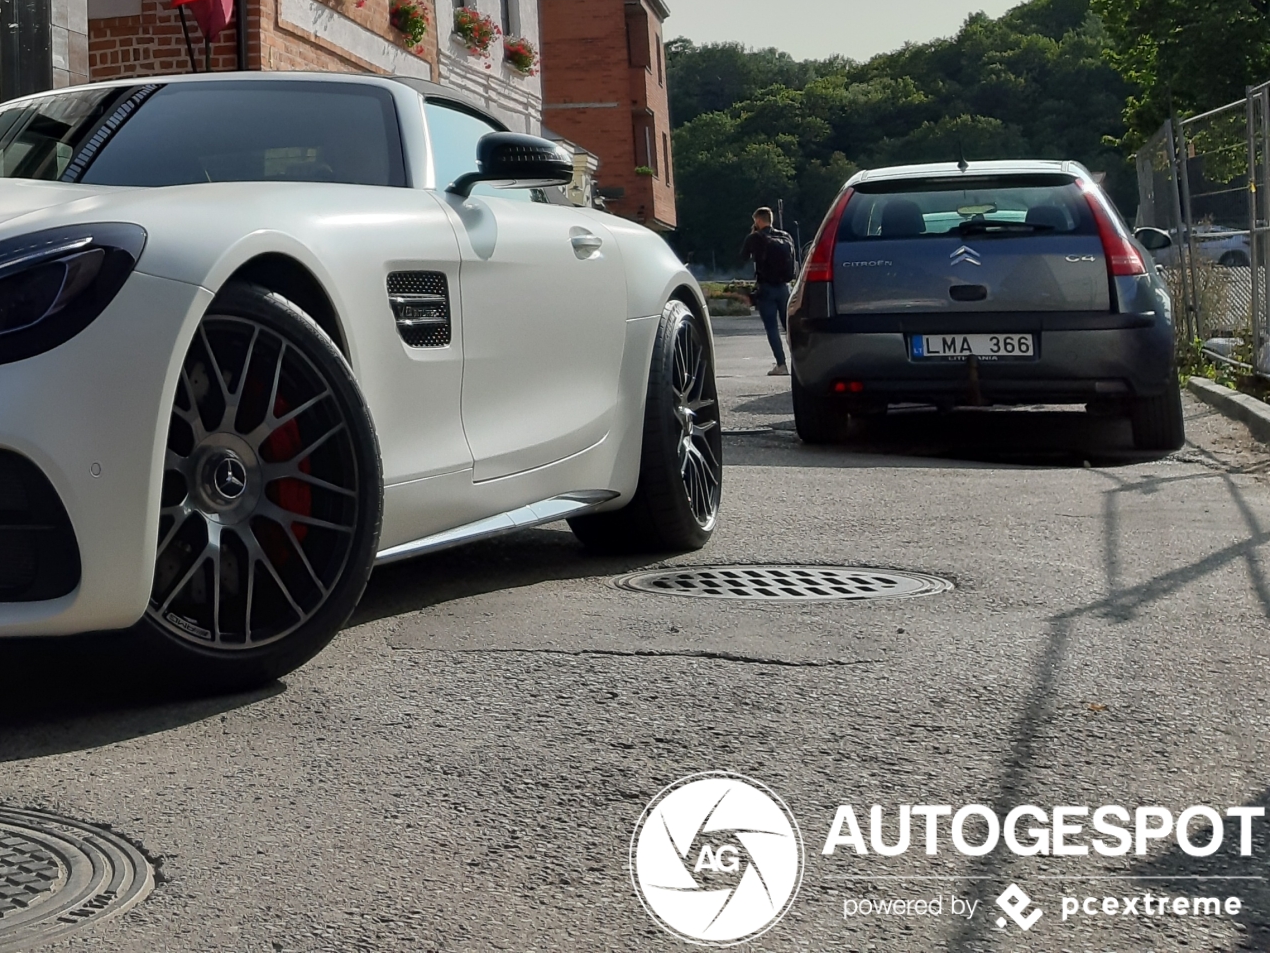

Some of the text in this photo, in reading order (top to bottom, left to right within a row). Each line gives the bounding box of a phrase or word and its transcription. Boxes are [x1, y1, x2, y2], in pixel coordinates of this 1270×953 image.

[1065, 254, 1096, 262] C4
[926, 336, 1030, 353] LMA 366
